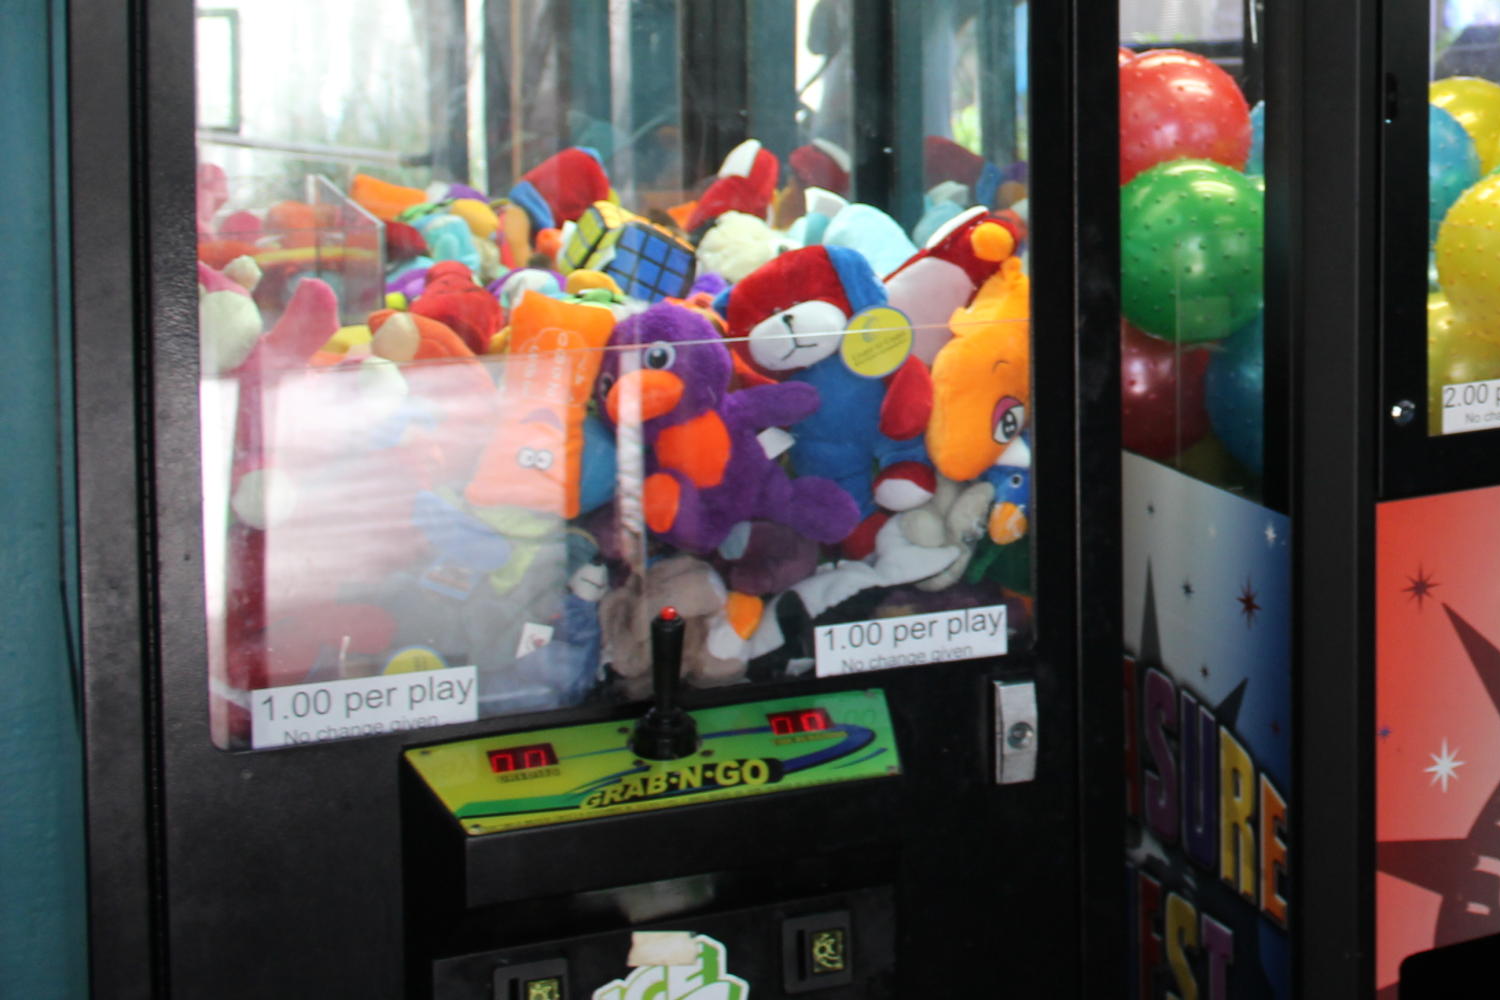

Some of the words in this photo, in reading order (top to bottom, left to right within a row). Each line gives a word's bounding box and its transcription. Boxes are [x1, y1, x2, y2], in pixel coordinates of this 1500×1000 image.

[1443, 383, 1489, 408] 2.00
[1465, 413, 1481, 423] No
[824, 622, 882, 650] 1.00
[893, 619, 939, 647] per
[948, 609, 1003, 640] play
[841, 659, 864, 673] No
[869, 651, 928, 668] change
[930, 645, 973, 661] given
[261, 689, 331, 721] 1.00
[344, 686, 398, 718] per
[409, 676, 474, 711] play
[283, 731, 311, 745] No
[315, 720, 385, 742] change
[388, 714, 440, 731] given
